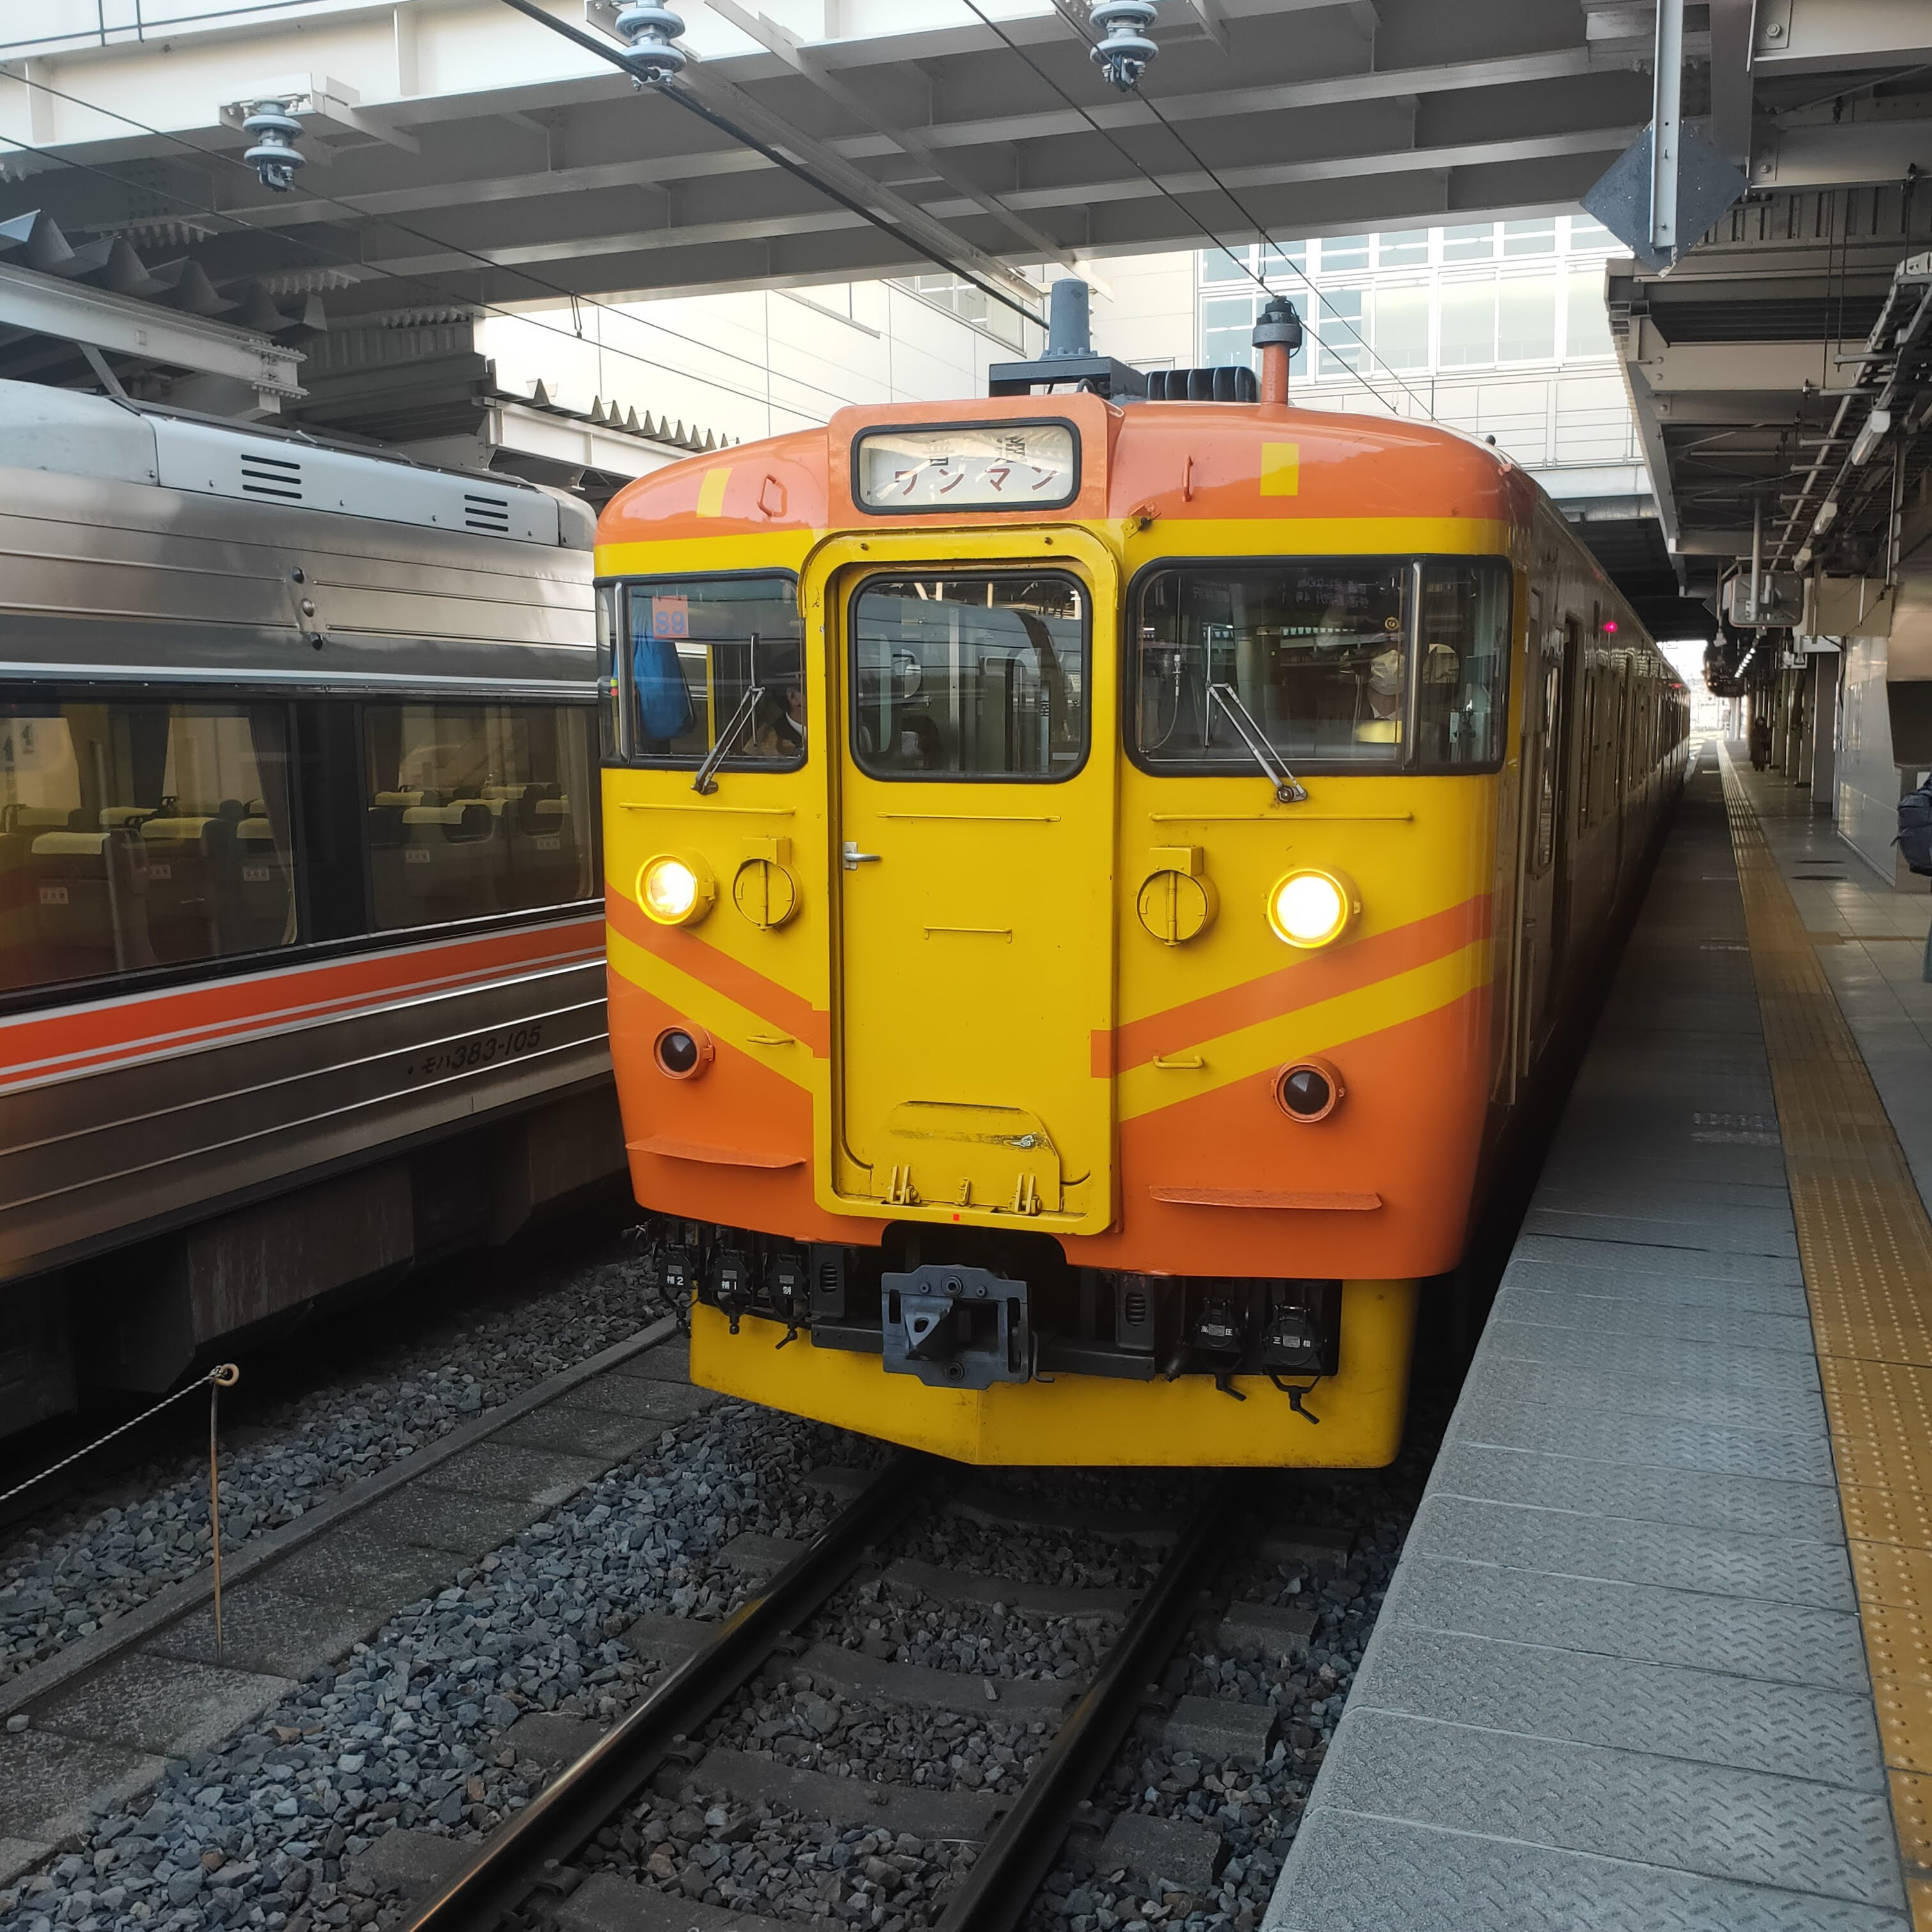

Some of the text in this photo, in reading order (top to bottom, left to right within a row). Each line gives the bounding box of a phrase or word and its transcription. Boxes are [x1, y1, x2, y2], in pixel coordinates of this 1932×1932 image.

[895, 467, 1057, 496] ワンマン
[656, 611, 685, 635] S9
